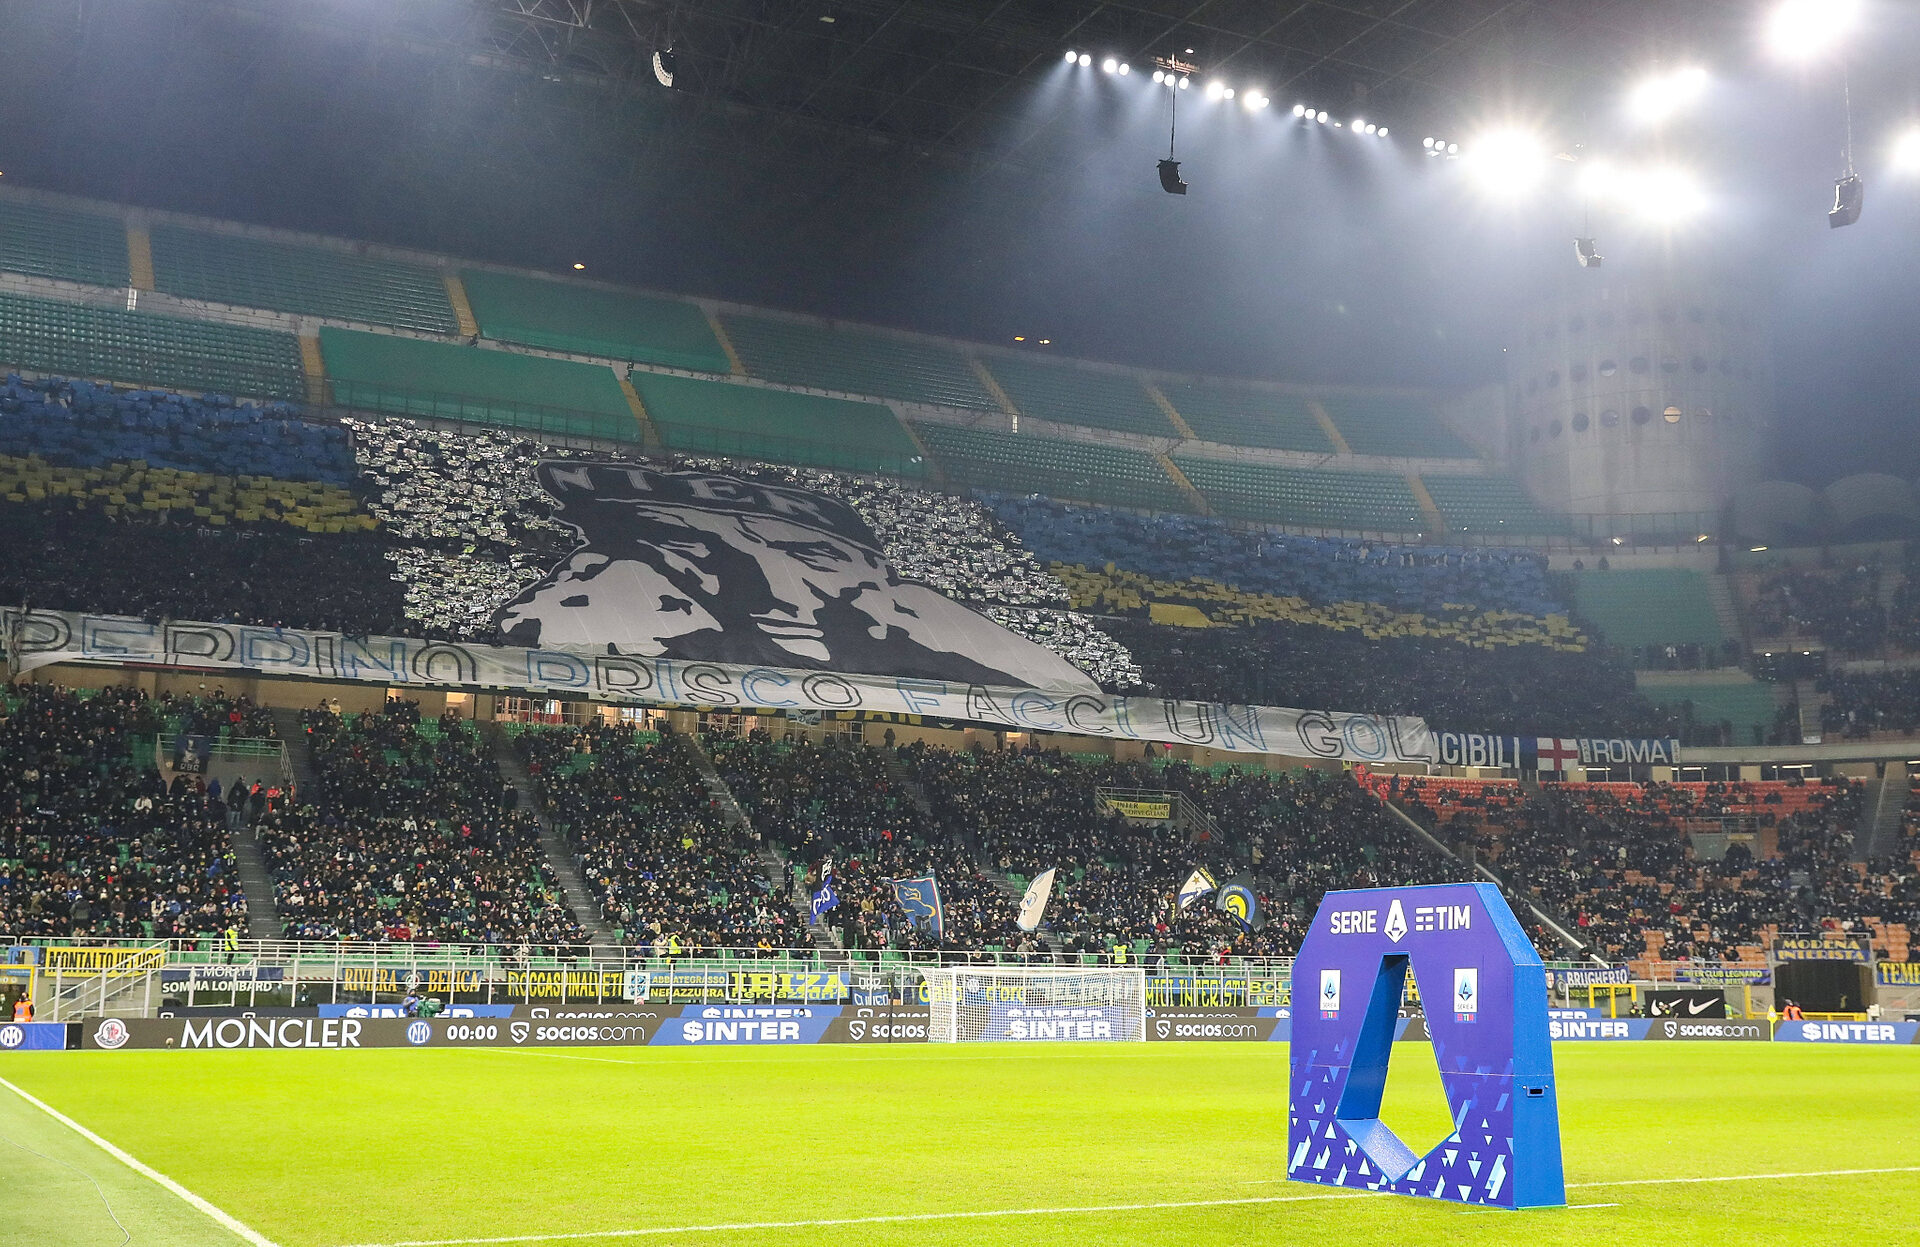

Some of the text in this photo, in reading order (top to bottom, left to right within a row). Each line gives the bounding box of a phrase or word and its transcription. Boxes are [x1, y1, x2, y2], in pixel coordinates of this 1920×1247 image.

[896, 677, 1137, 738] FACCI
[1164, 700, 1268, 751] UN
[1297, 711, 1432, 765] GOL
[1592, 738, 1669, 764] ROMA
[1330, 910, 1378, 934] SERIE
[1436, 905, 1471, 931] TIM
[1777, 950, 1865, 960] INTERISTA
[1782, 940, 1860, 949] MODENA
[49, 951, 113, 973] MONTALTO
[162, 981, 209, 993] SOMMA
[343, 968, 480, 993] RIVIERA BERICA
[731, 972, 848, 993] IBIZA
[1566, 968, 1628, 986] BRUGHERIO
[650, 986, 725, 998] NERAZZURRA
[180, 1018, 362, 1048] MONCLER
[446, 1025, 498, 1041] 00:00
[683, 1020, 801, 1043] $INTER
